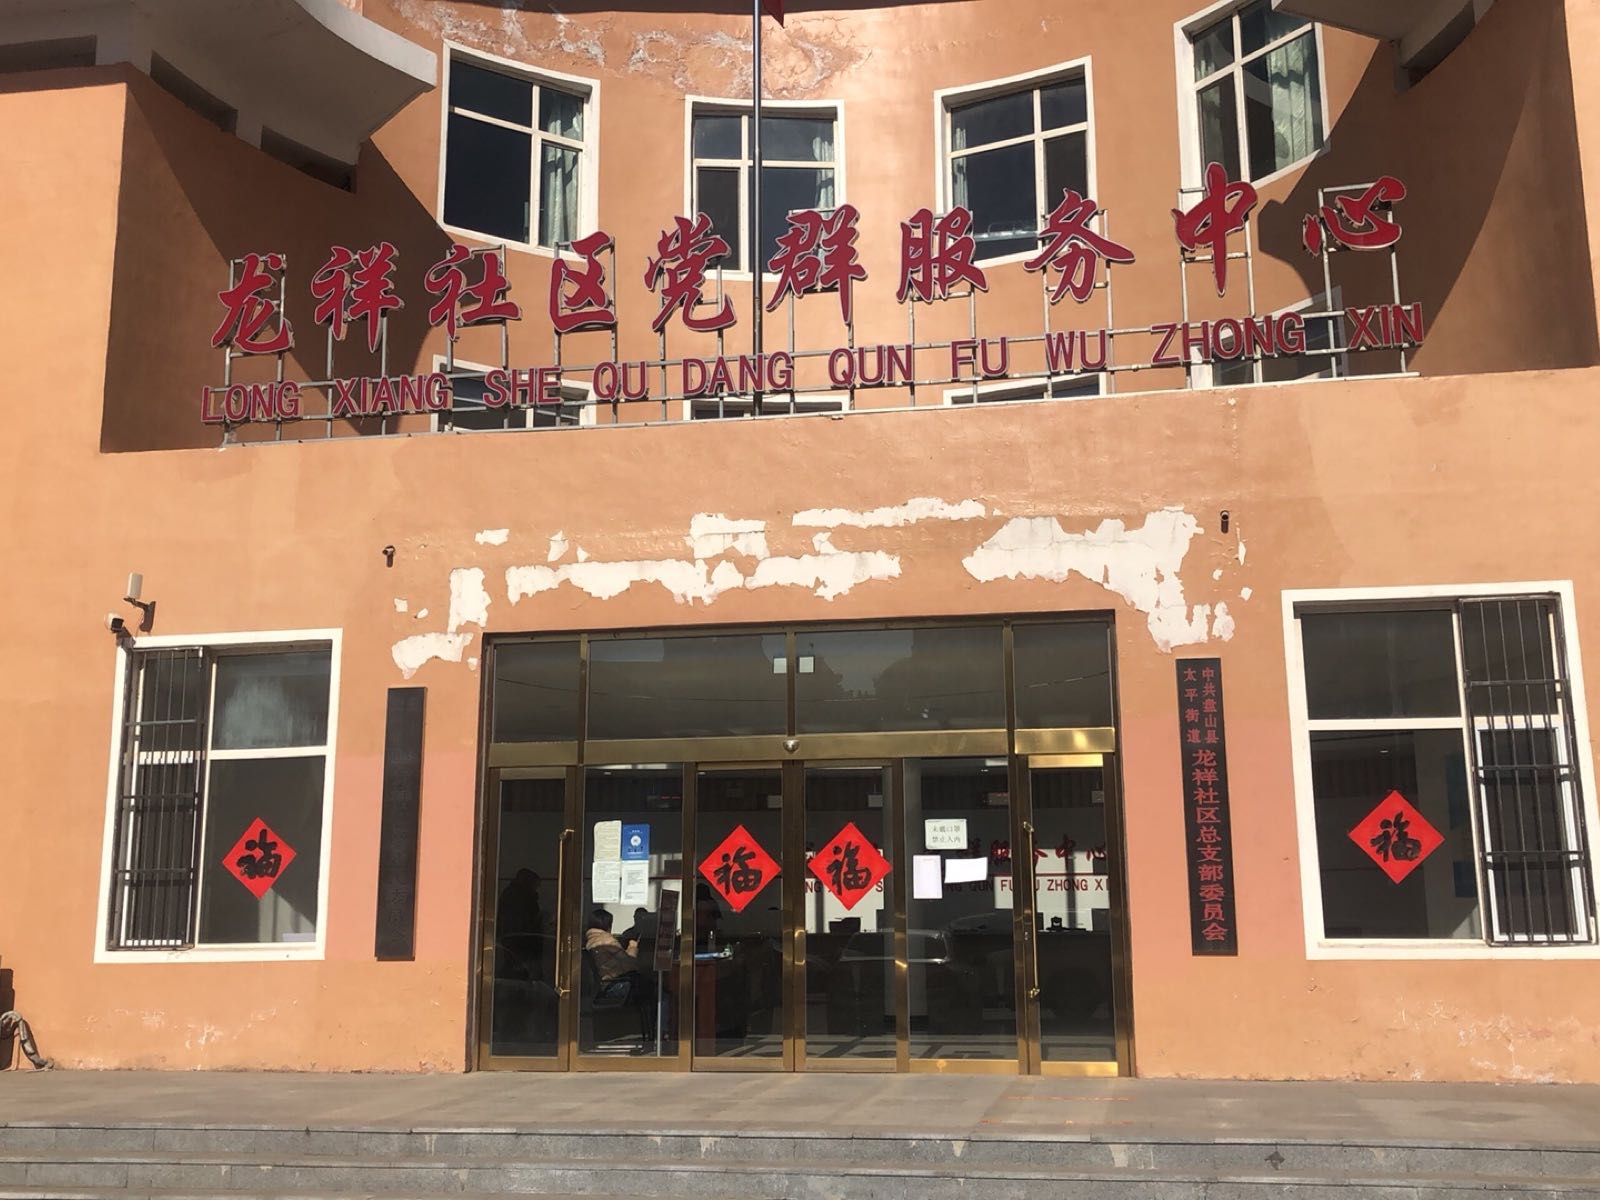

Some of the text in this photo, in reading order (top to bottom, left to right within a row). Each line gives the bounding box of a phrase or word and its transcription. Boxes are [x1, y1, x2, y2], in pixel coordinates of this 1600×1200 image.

[212, 162, 1407, 354] 龙祥社区党群服务中心
[201, 302, 1424, 424] LONG XIANG SHE QU DANG QUN FU WU ZHONG XIN
[1183, 668, 1201, 744] 太平街道
[236, 828, 281, 880] 福
[1192, 749, 1228, 941] 龙祥社区总支部委员会
[1370, 811, 1422, 863] 福
[713, 846, 763, 894] 福
[826, 841, 872, 896] 福
[1047, 879, 1088, 892] ZHONG
